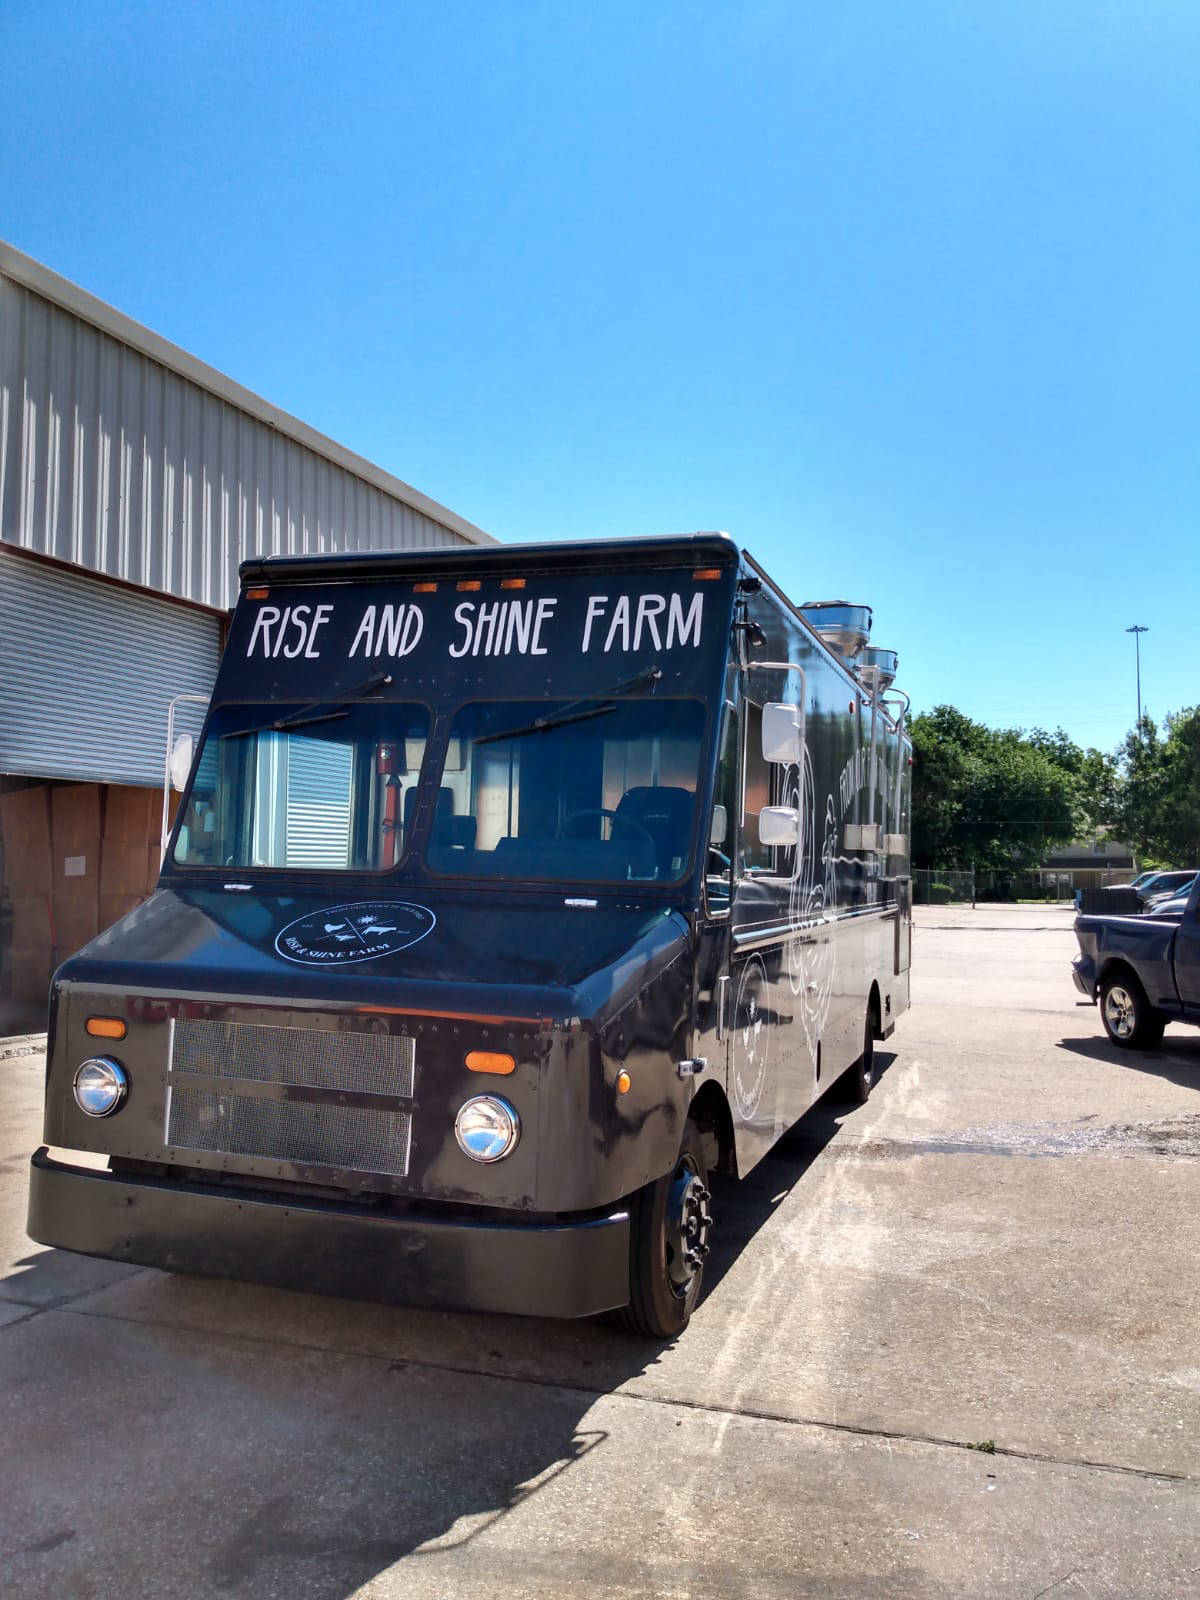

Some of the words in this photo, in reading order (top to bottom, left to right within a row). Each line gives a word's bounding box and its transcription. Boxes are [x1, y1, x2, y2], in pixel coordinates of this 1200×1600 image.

[246, 604, 334, 659] RISE
[348, 604, 425, 659] AND
[448, 597, 558, 659] SHINE
[581, 592, 704, 653] FARM
[285, 937, 302, 950] RISE
[307, 950, 346, 958] SHINE
[349, 943, 390, 957] FARM
